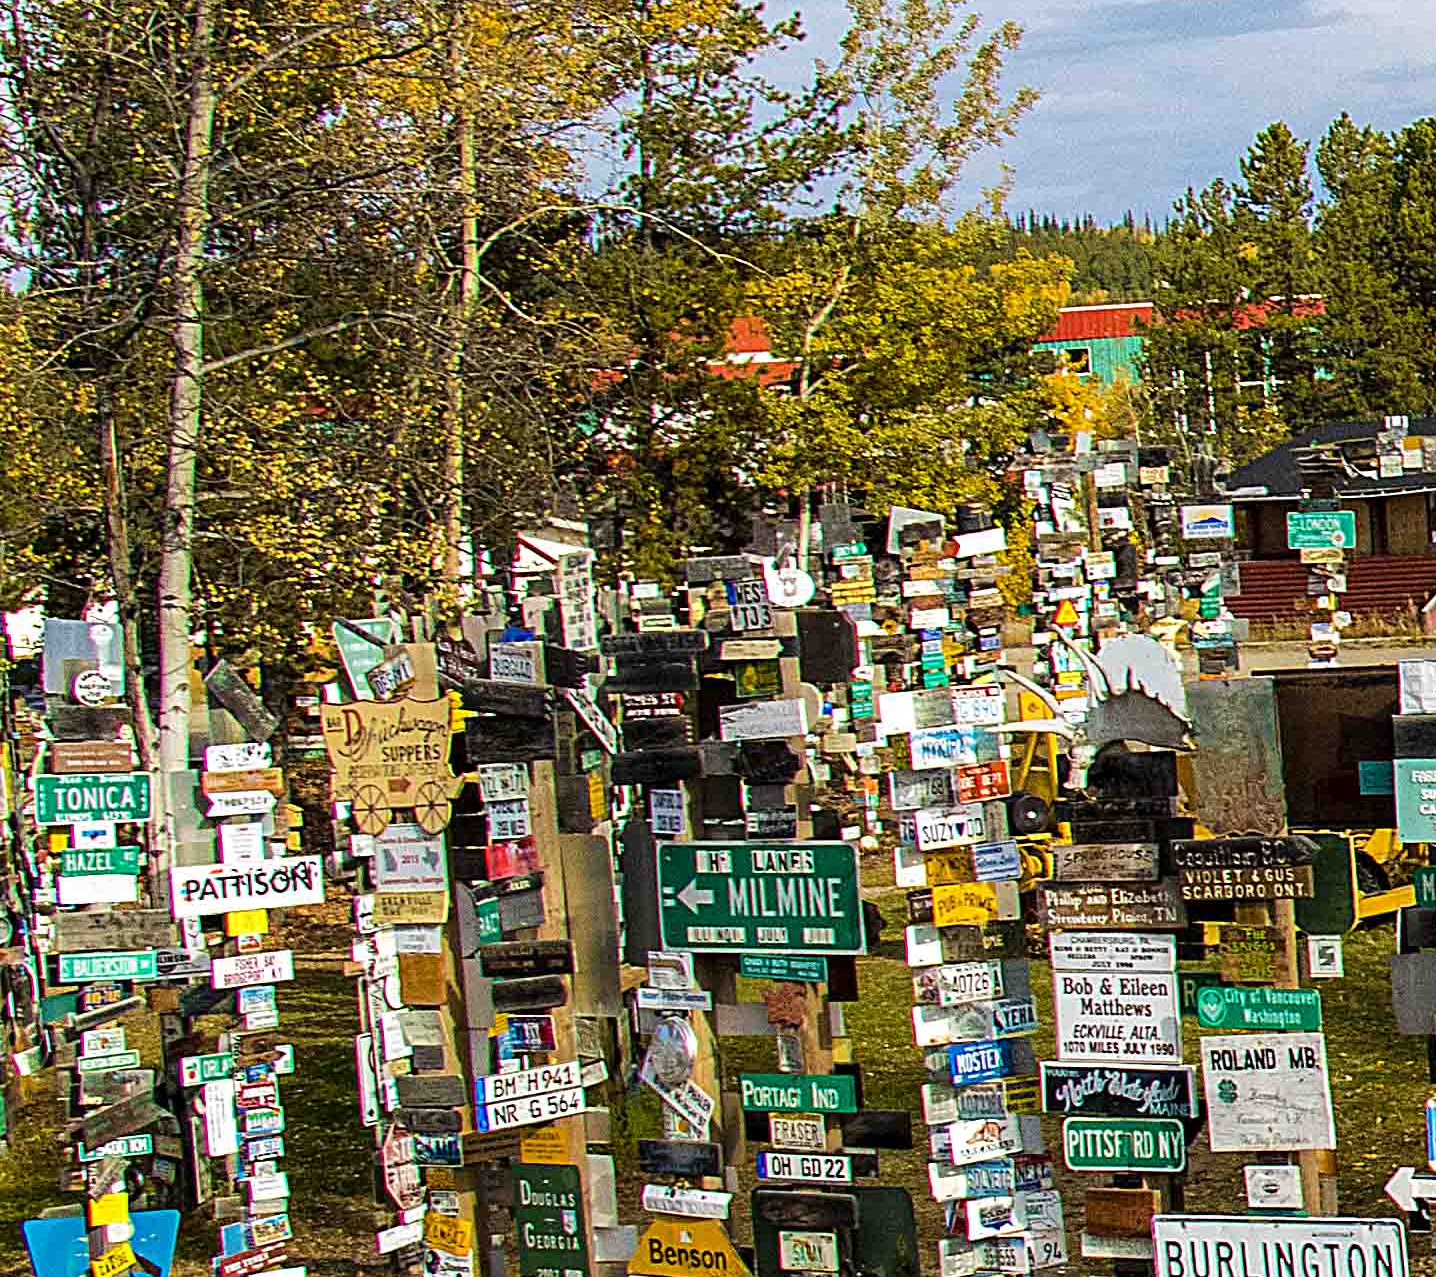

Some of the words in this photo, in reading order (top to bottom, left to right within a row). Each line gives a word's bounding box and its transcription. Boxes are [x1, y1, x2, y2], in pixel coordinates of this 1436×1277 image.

[54, 787, 136, 810] TONICA
[65, 855, 113, 871] HAZEL
[728, 878, 845, 918] MILMINE
[1063, 977, 1095, 997] Bob
[1100, 978, 1114, 996] &
[1119, 976, 1169, 996] Eileen
[1081, 998, 1153, 1018] Matthews
[1243, 1006, 1302, 1026] Washington
[648, 1238, 727, 1270] Benson
